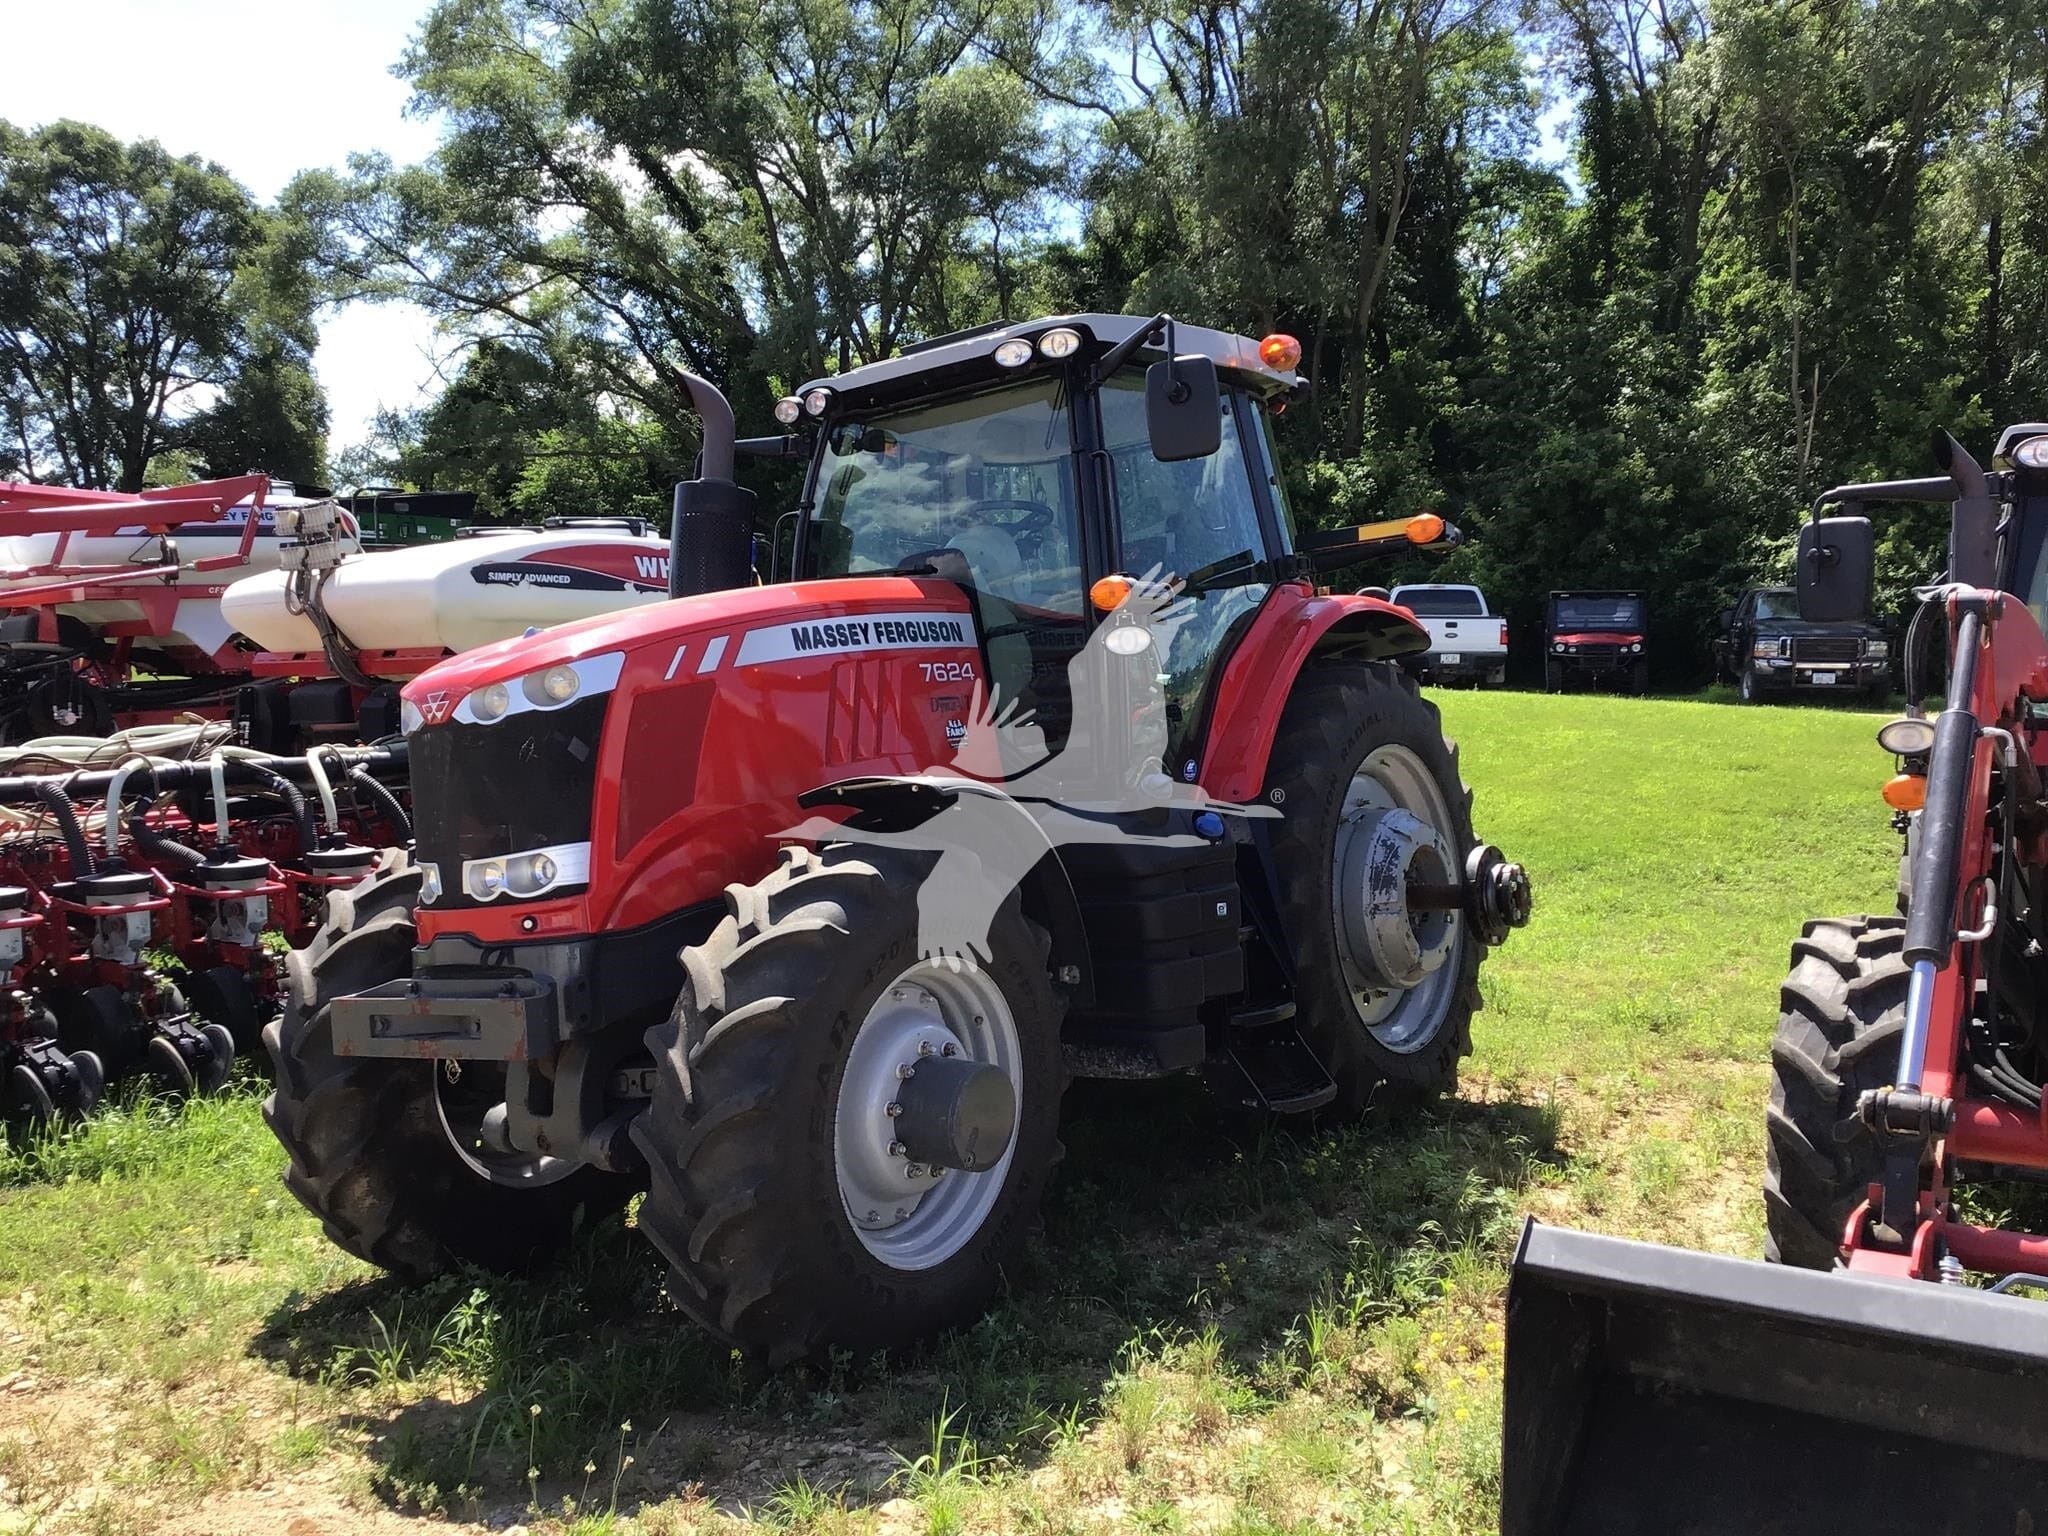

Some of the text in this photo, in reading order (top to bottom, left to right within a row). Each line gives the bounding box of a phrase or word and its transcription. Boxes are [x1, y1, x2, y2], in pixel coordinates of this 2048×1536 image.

[487, 571, 572, 584] SIMPLY ADVANCED
[790, 620, 965, 652] MASSEY FERGUSON
[918, 662, 976, 682] 7624
